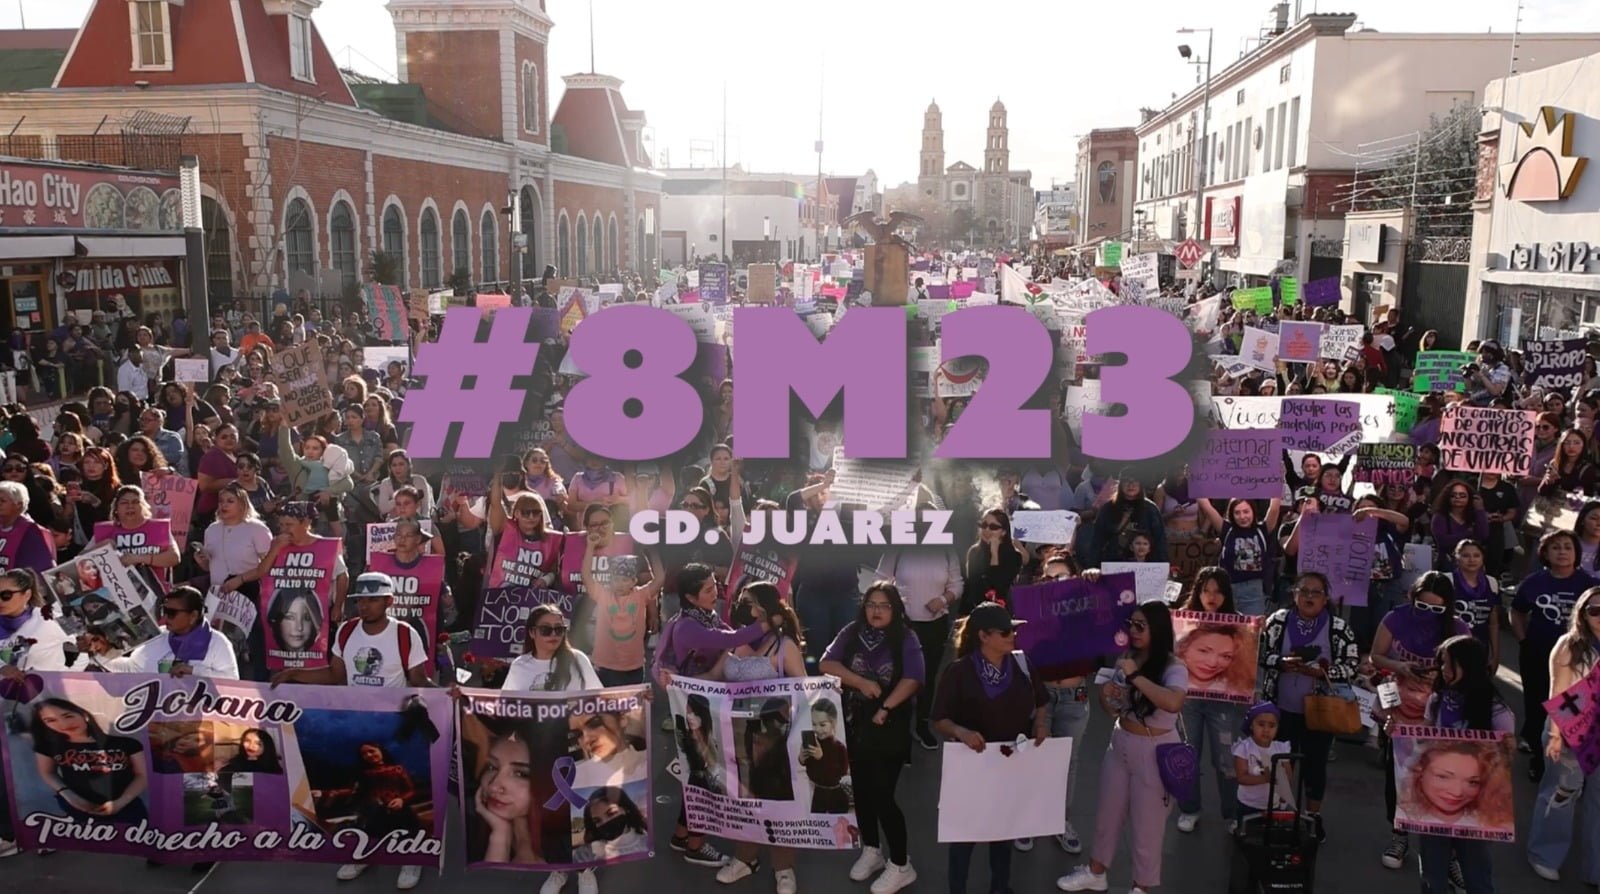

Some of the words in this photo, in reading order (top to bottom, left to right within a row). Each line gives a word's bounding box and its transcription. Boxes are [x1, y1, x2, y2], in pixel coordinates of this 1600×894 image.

[0, 170, 37, 207] Hao
[43, 173, 80, 215] City
[1527, 341, 1543, 352] NO
[1545, 341, 1564, 351] ES
[1533, 350, 1586, 369] PIROPO
[1535, 372, 1583, 388] ACOSO
[1334, 403, 1353, 418] las
[1442, 432, 1532, 453] NOSOTRAS
[1442, 449, 1462, 467] DE
[1465, 450, 1532, 473] VIVIRLO
[117, 533, 146, 547] NO
[286, 553, 314, 567] NO
[502, 560, 515, 570] ME
[517, 548, 543, 566] NO
[270, 568, 284, 577] ME
[287, 569, 325, 578] OLVIDEN
[505, 573, 531, 587] FALTO
[275, 579, 301, 588] FALTO
[303, 580, 316, 588] YO
[391, 577, 418, 593] NO
[484, 588, 522, 605] LAS
[386, 608, 408, 617] ALTO
[411, 608, 422, 617] YO
[480, 605, 519, 624] NO
[479, 624, 526, 643] TOC
[707, 686, 732, 696] PARA
[763, 683, 776, 694] NO
[778, 682, 790, 693] TE
[116, 680, 302, 732] Johana
[463, 696, 533, 719] Justicia
[537, 702, 568, 723] por
[574, 695, 639, 717] Johana
[1400, 726, 1497, 740] DESAPARECIDA
[773, 820, 784, 828] NO
[124, 819, 247, 851] derecho
[253, 831, 282, 850] a
[288, 823, 326, 851] la
[332, 828, 442, 860] Vida
